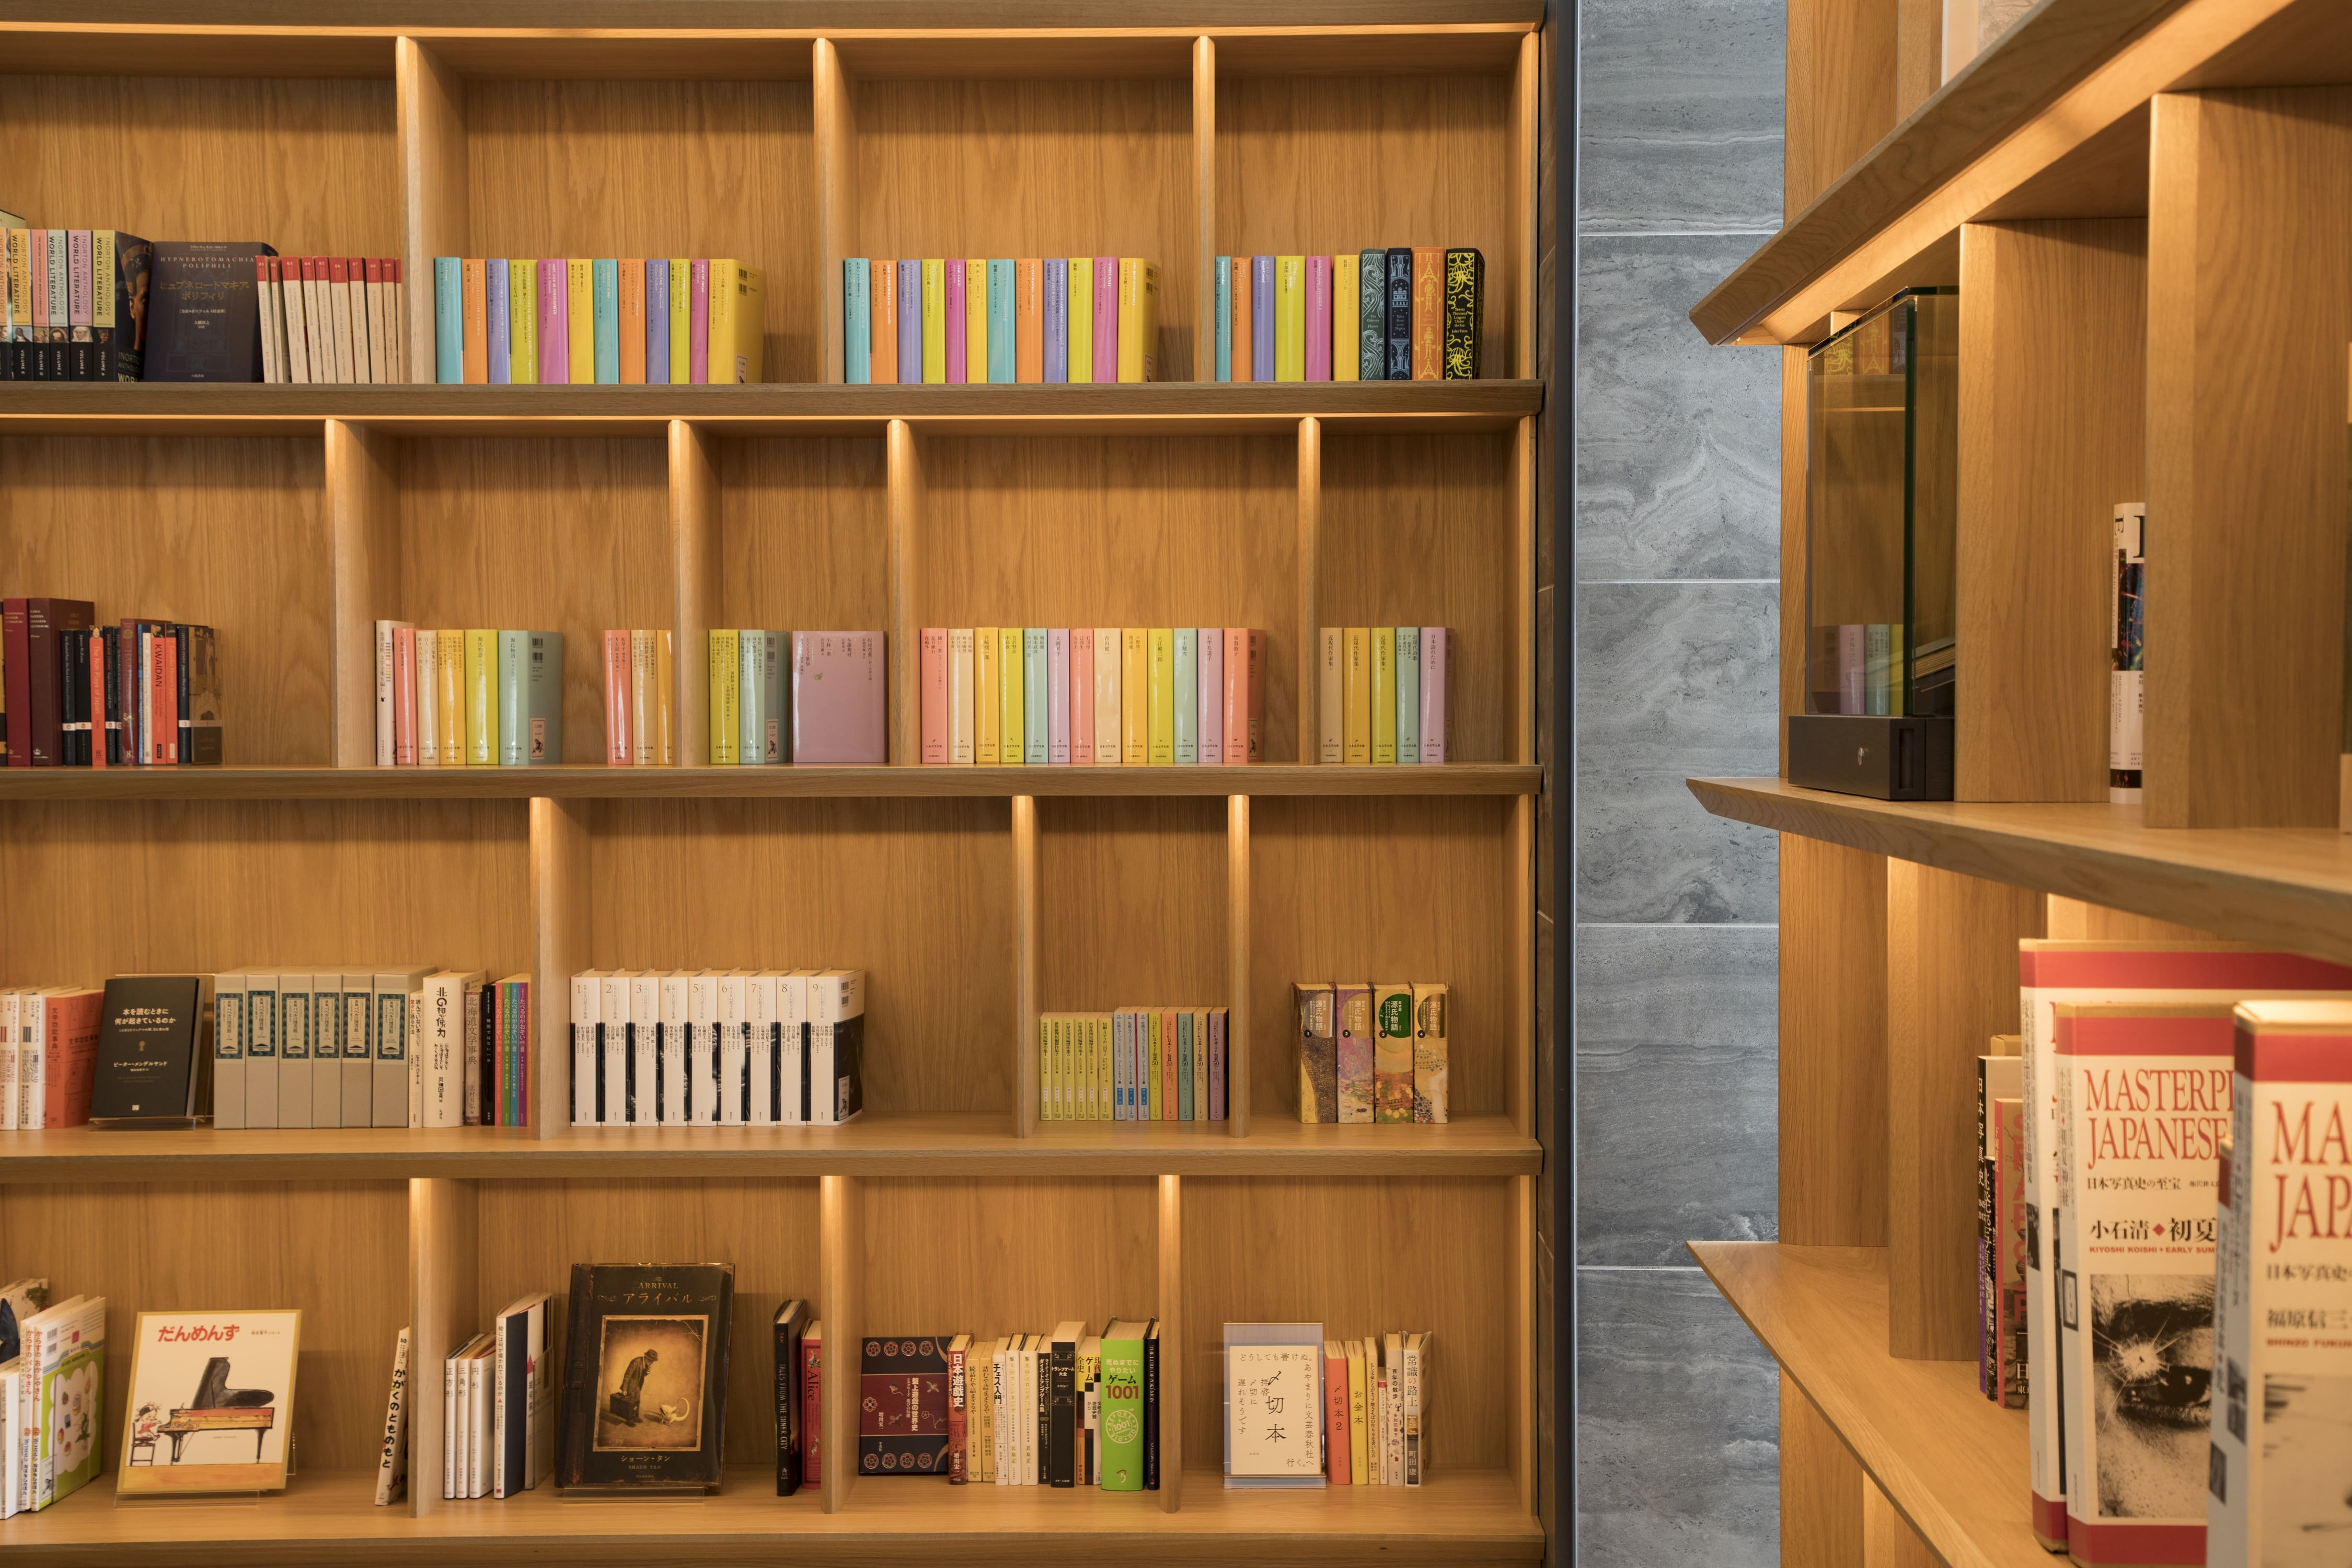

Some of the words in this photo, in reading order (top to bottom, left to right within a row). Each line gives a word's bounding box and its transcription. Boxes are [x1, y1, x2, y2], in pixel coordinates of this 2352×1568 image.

[182, 291, 225, 301] ポリフィリ
[577, 985, 580, 993] 1
[606, 984, 612, 993] 2
[636, 984, 642, 993] 3
[664, 984, 670, 993] 4
[693, 984, 698, 993] 5
[722, 984, 727, 993] 6
[752, 984, 757, 993] 7
[782, 983, 787, 993] 8
[813, 983, 818, 993] 9
[468, 997, 477, 1065] 北海道文学事典
[2087, 1177, 2186, 1191] 日本写真史の至宝
[2269, 1174, 2352, 1254] JAP
[622, 1293, 693, 1305] アライバル
[2266, 1308, 2348, 1330] 福原信三
[157, 1324, 240, 1342] だんめんず
[1078, 1357, 1085, 1373] 全史
[1094, 1357, 1101, 1373] 現代
[1240, 1353, 1312, 1362] どうしても書けぬ。
[472, 1368, 479, 1390] 円形
[808, 1370, 818, 1401] Alice
[953, 1353, 964, 1408] 日本遊戯史
[993, 1364, 1002, 1404] チェス入門
[1108, 1375, 1137, 1384] ゲーム
[1261, 1378, 1270, 1396] 拝啓
[1406, 1355, 1417, 1407] 常識の路上
[1105, 1385, 1139, 1399] 1001
[1249, 1379, 1258, 1405] 〆切に
[1087, 1402, 1091, 1410] から
[1237, 1378, 1246, 1434] 遅れそうです
[1265, 1370, 1286, 1443] 〆切本
[1334, 1386, 1344, 1431] 〆切本2
[1353, 1391, 1364, 1425] お金本
[383, 1369, 406, 1469] かがくのとものもと
[1304, 1364, 1314, 1465] あやまりに文芸春秋社へ
[1113, 1420, 1131, 1432] 1001
[1286, 1459, 1306, 1468] 行く。
[1409, 1450, 1417, 1476] 町田康
